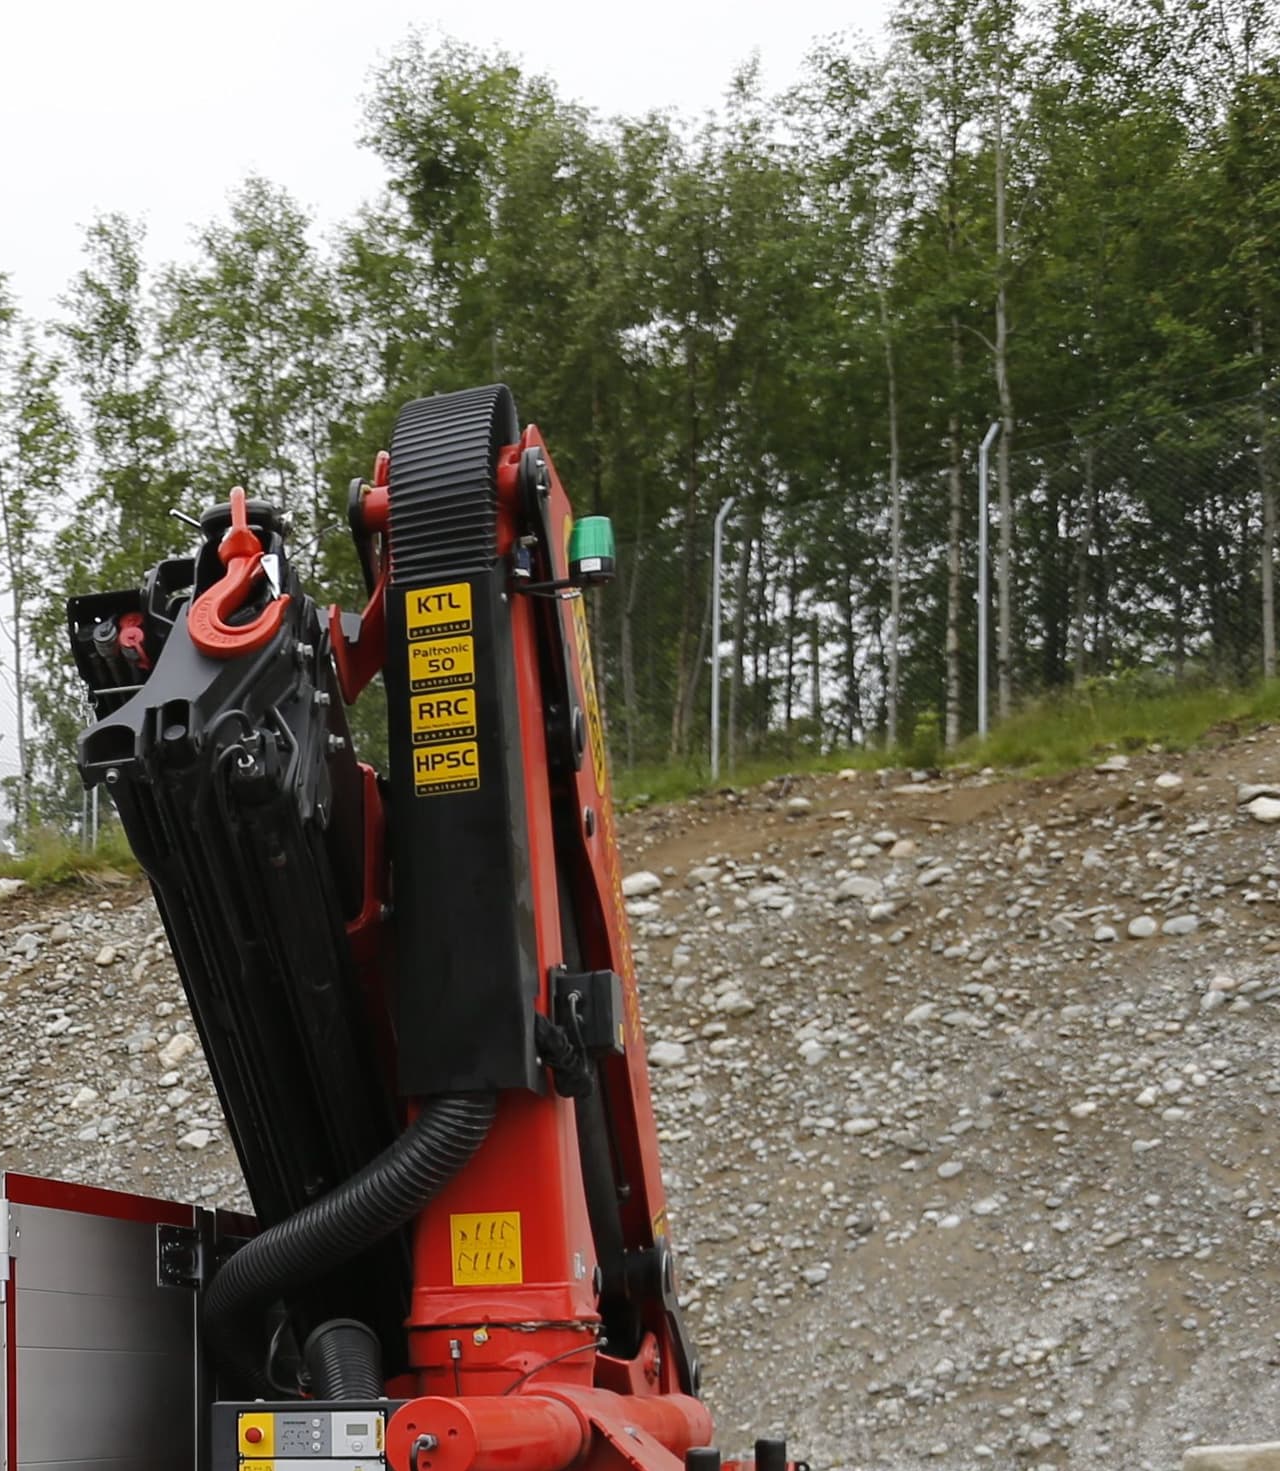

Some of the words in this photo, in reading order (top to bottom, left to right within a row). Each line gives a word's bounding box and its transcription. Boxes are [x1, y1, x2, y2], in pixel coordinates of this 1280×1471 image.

[417, 592, 461, 614] KTL
[413, 644, 469, 659] Paltronic
[428, 657, 455, 673] 50
[418, 697, 468, 719] RRC
[416, 748, 475, 773] HPSC
